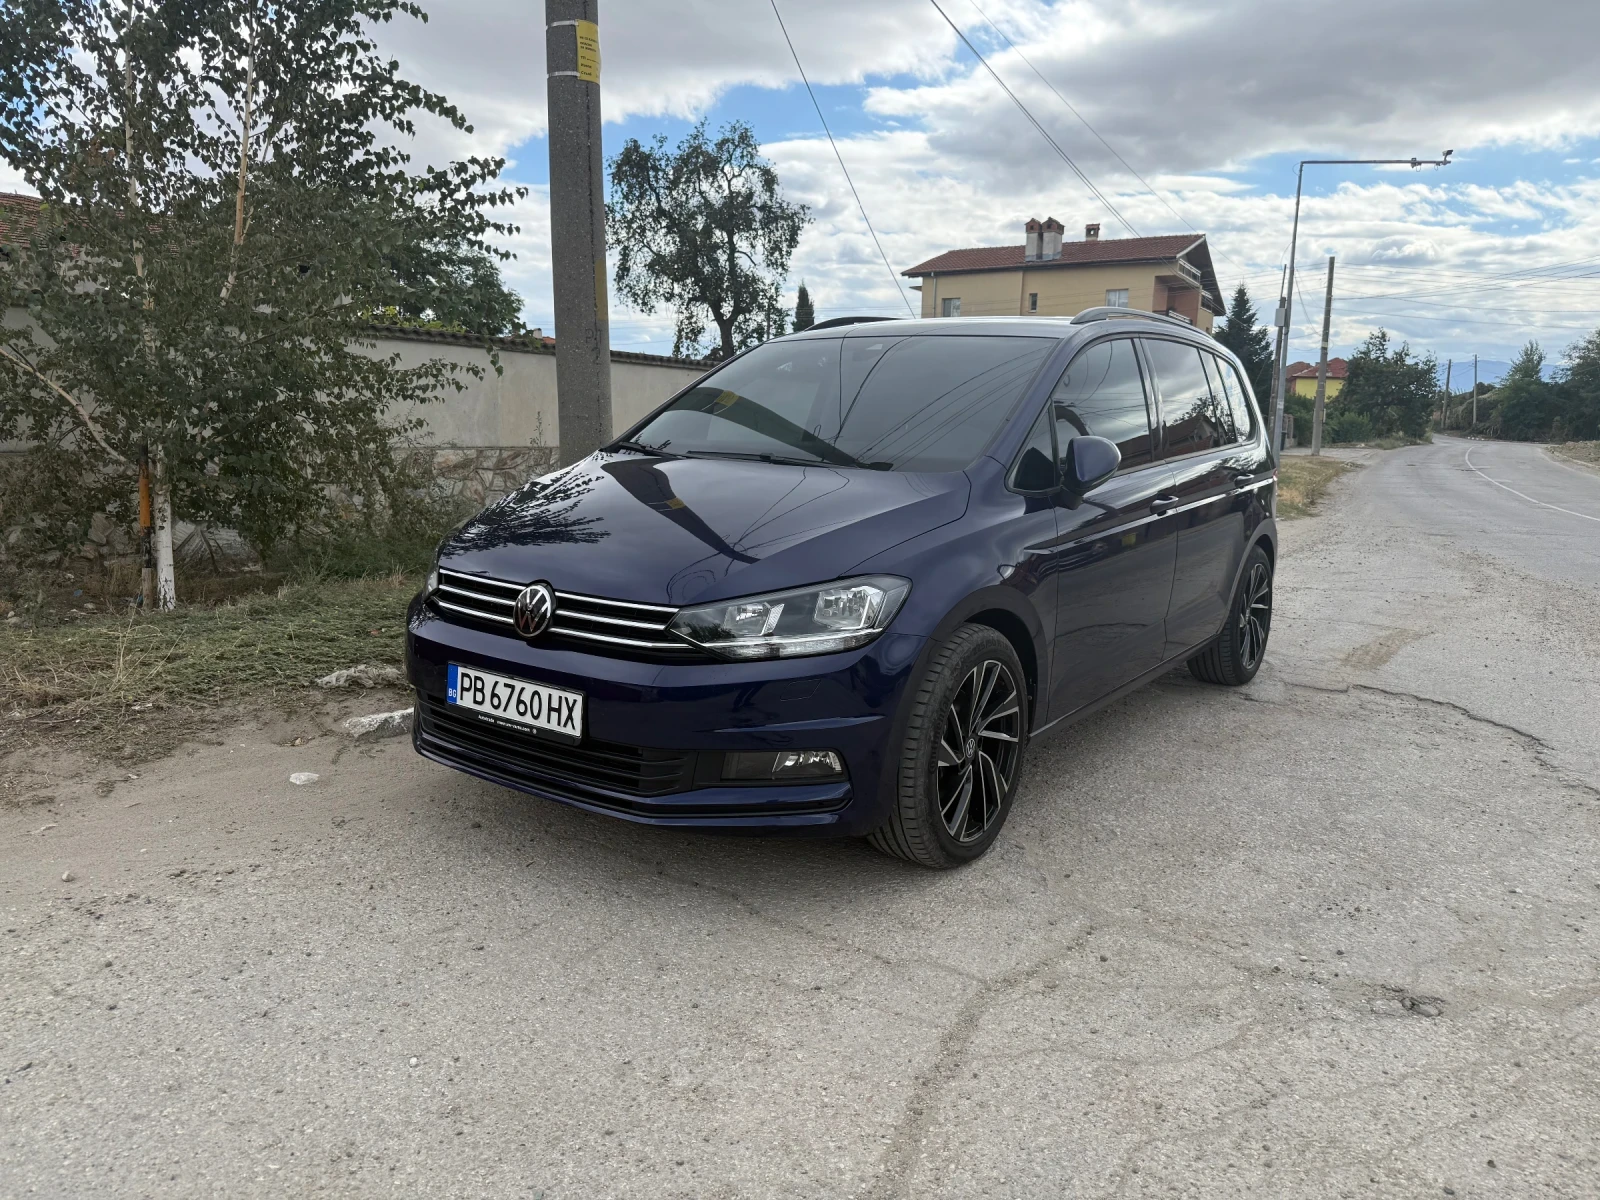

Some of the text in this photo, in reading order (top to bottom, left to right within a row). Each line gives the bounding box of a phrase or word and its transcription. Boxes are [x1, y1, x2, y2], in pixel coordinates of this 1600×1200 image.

[448, 687, 457, 698] BG
[460, 672, 578, 730] PB 6760 HX
